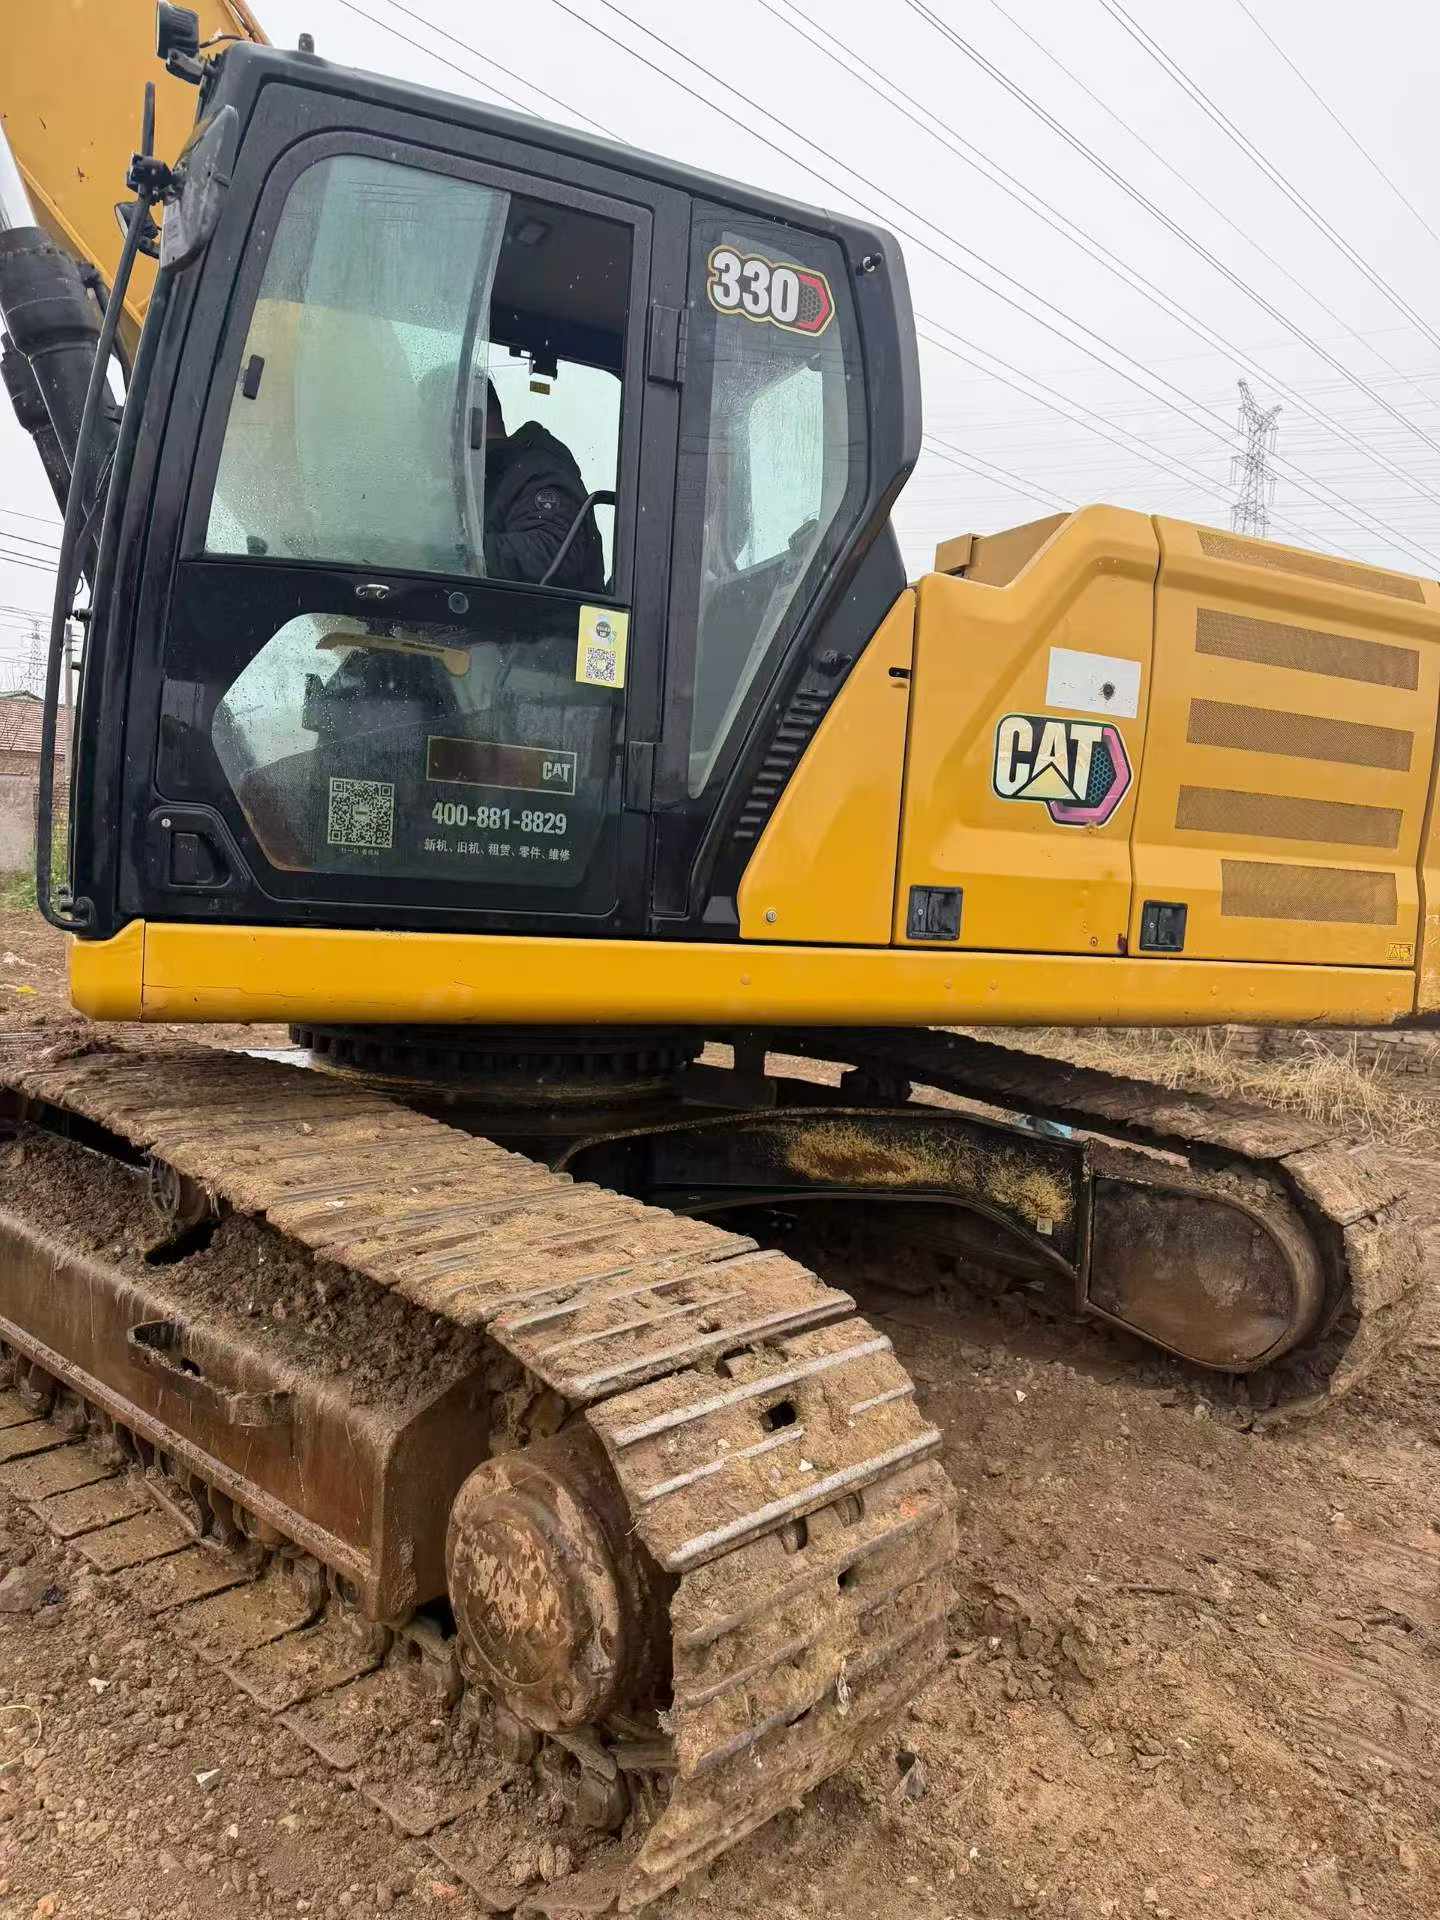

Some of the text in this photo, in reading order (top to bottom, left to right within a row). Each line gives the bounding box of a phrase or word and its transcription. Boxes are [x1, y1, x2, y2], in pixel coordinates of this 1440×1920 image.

[713, 251, 800, 322] 330
[542, 761, 571, 783] CAT
[998, 717, 1104, 800] CAT
[431, 801, 567, 835] 400-881-8829
